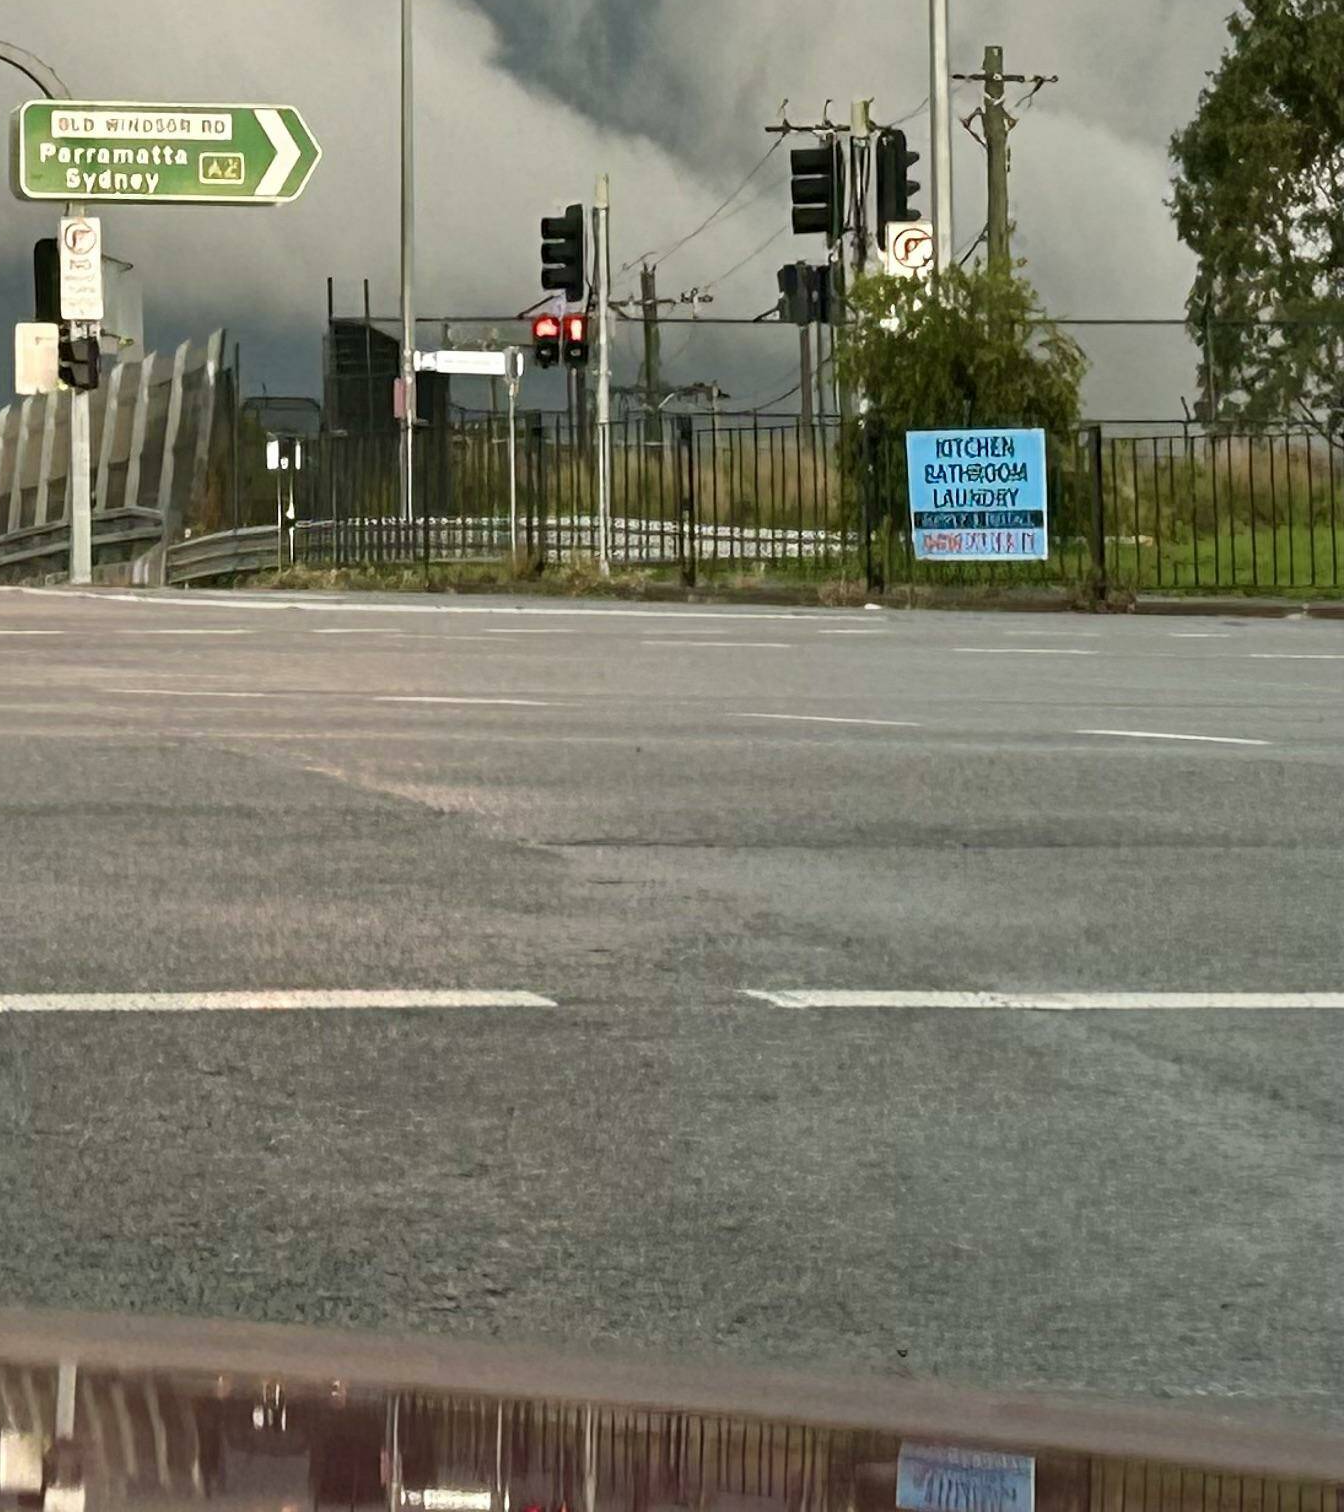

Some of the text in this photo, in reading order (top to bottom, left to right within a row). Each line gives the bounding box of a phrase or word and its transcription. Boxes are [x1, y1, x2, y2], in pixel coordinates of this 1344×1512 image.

[58, 117, 225, 134] OLD WINDSOR RD
[39, 142, 188, 166] Parramatta
[207, 159, 240, 178] A2
[65, 168, 159, 194] Sydney
[935, 437, 1015, 459] KITCHEN
[924, 462, 1028, 484] BATHROOM
[933, 488, 1020, 508] LAUNDRY
